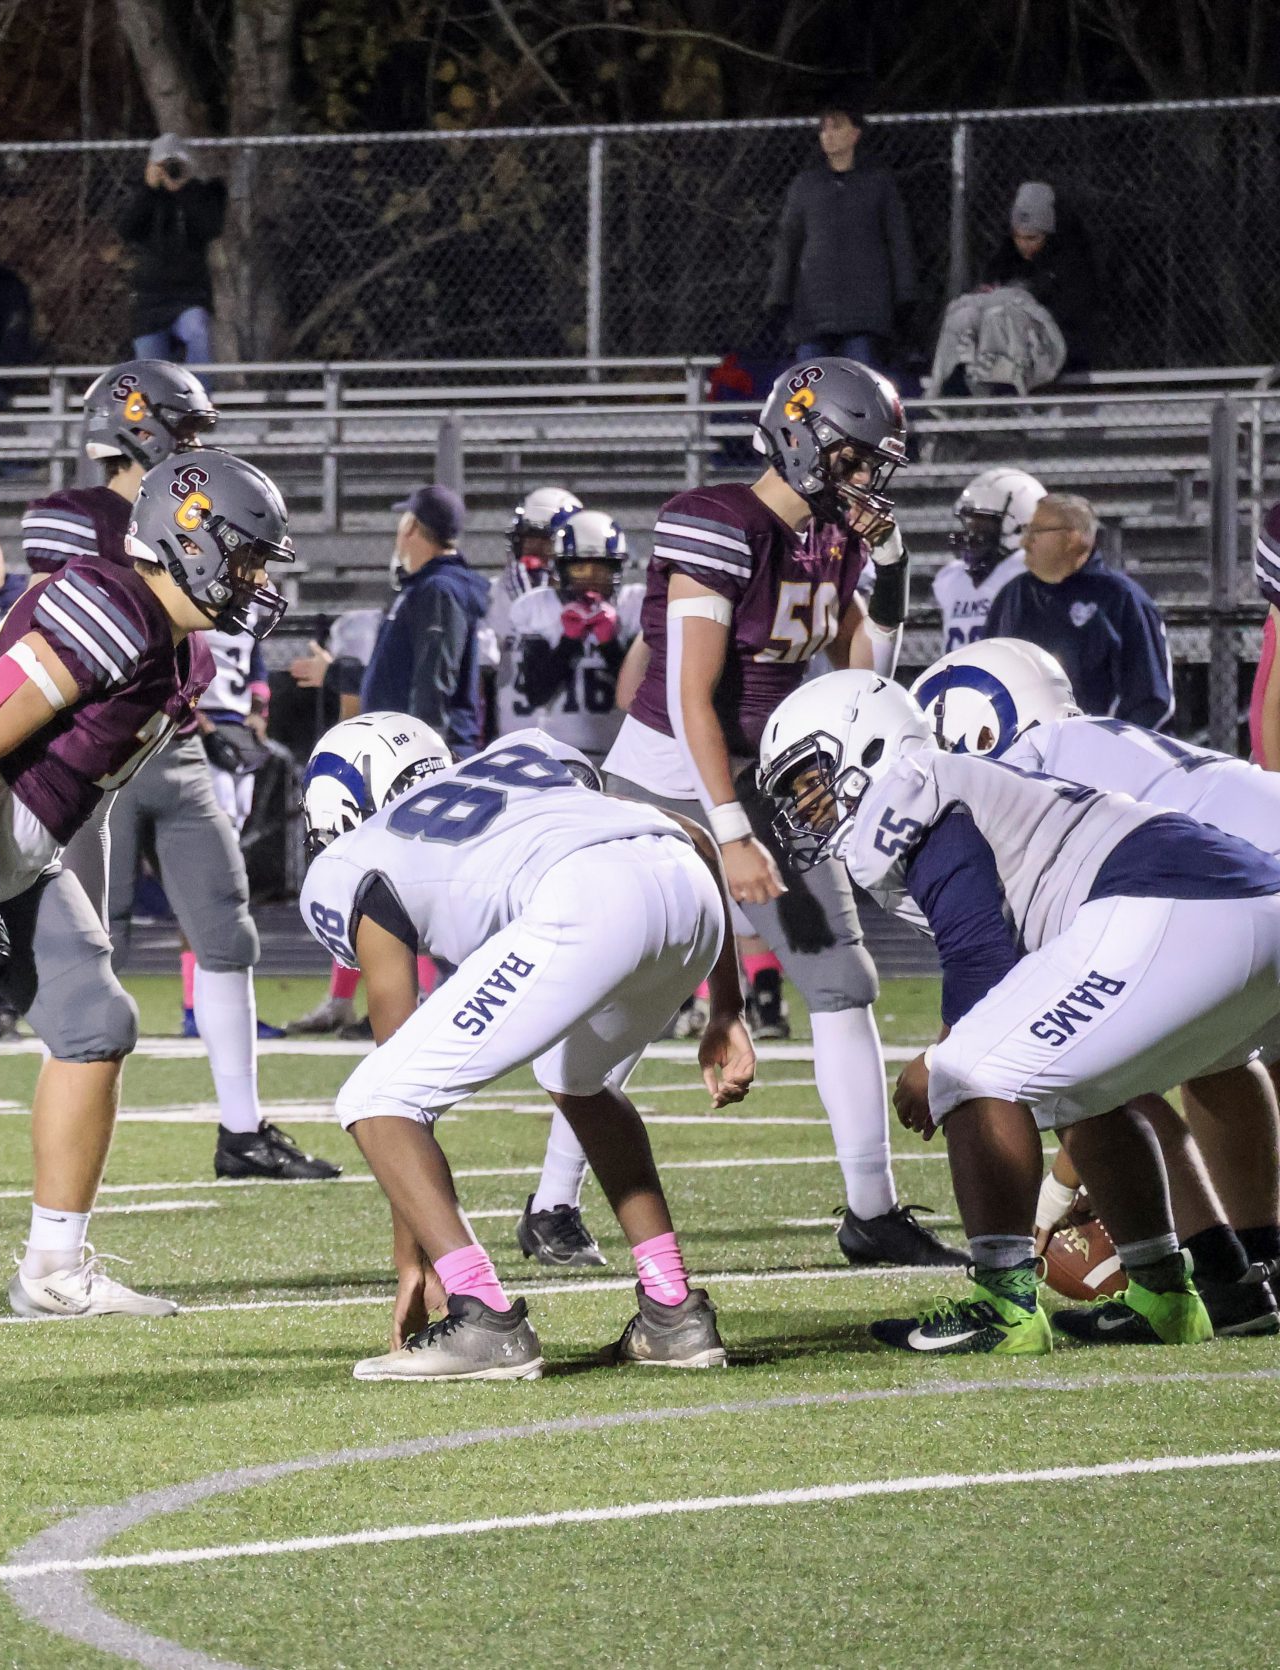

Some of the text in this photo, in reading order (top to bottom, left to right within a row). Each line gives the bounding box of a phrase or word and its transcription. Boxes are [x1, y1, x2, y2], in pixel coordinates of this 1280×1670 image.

[393, 733, 410, 746] 88
[386, 744, 578, 847] 88
[873, 806, 922, 857] 55
[452, 952, 536, 1036] RAMS
[1030, 970, 1127, 1046] RAMS
